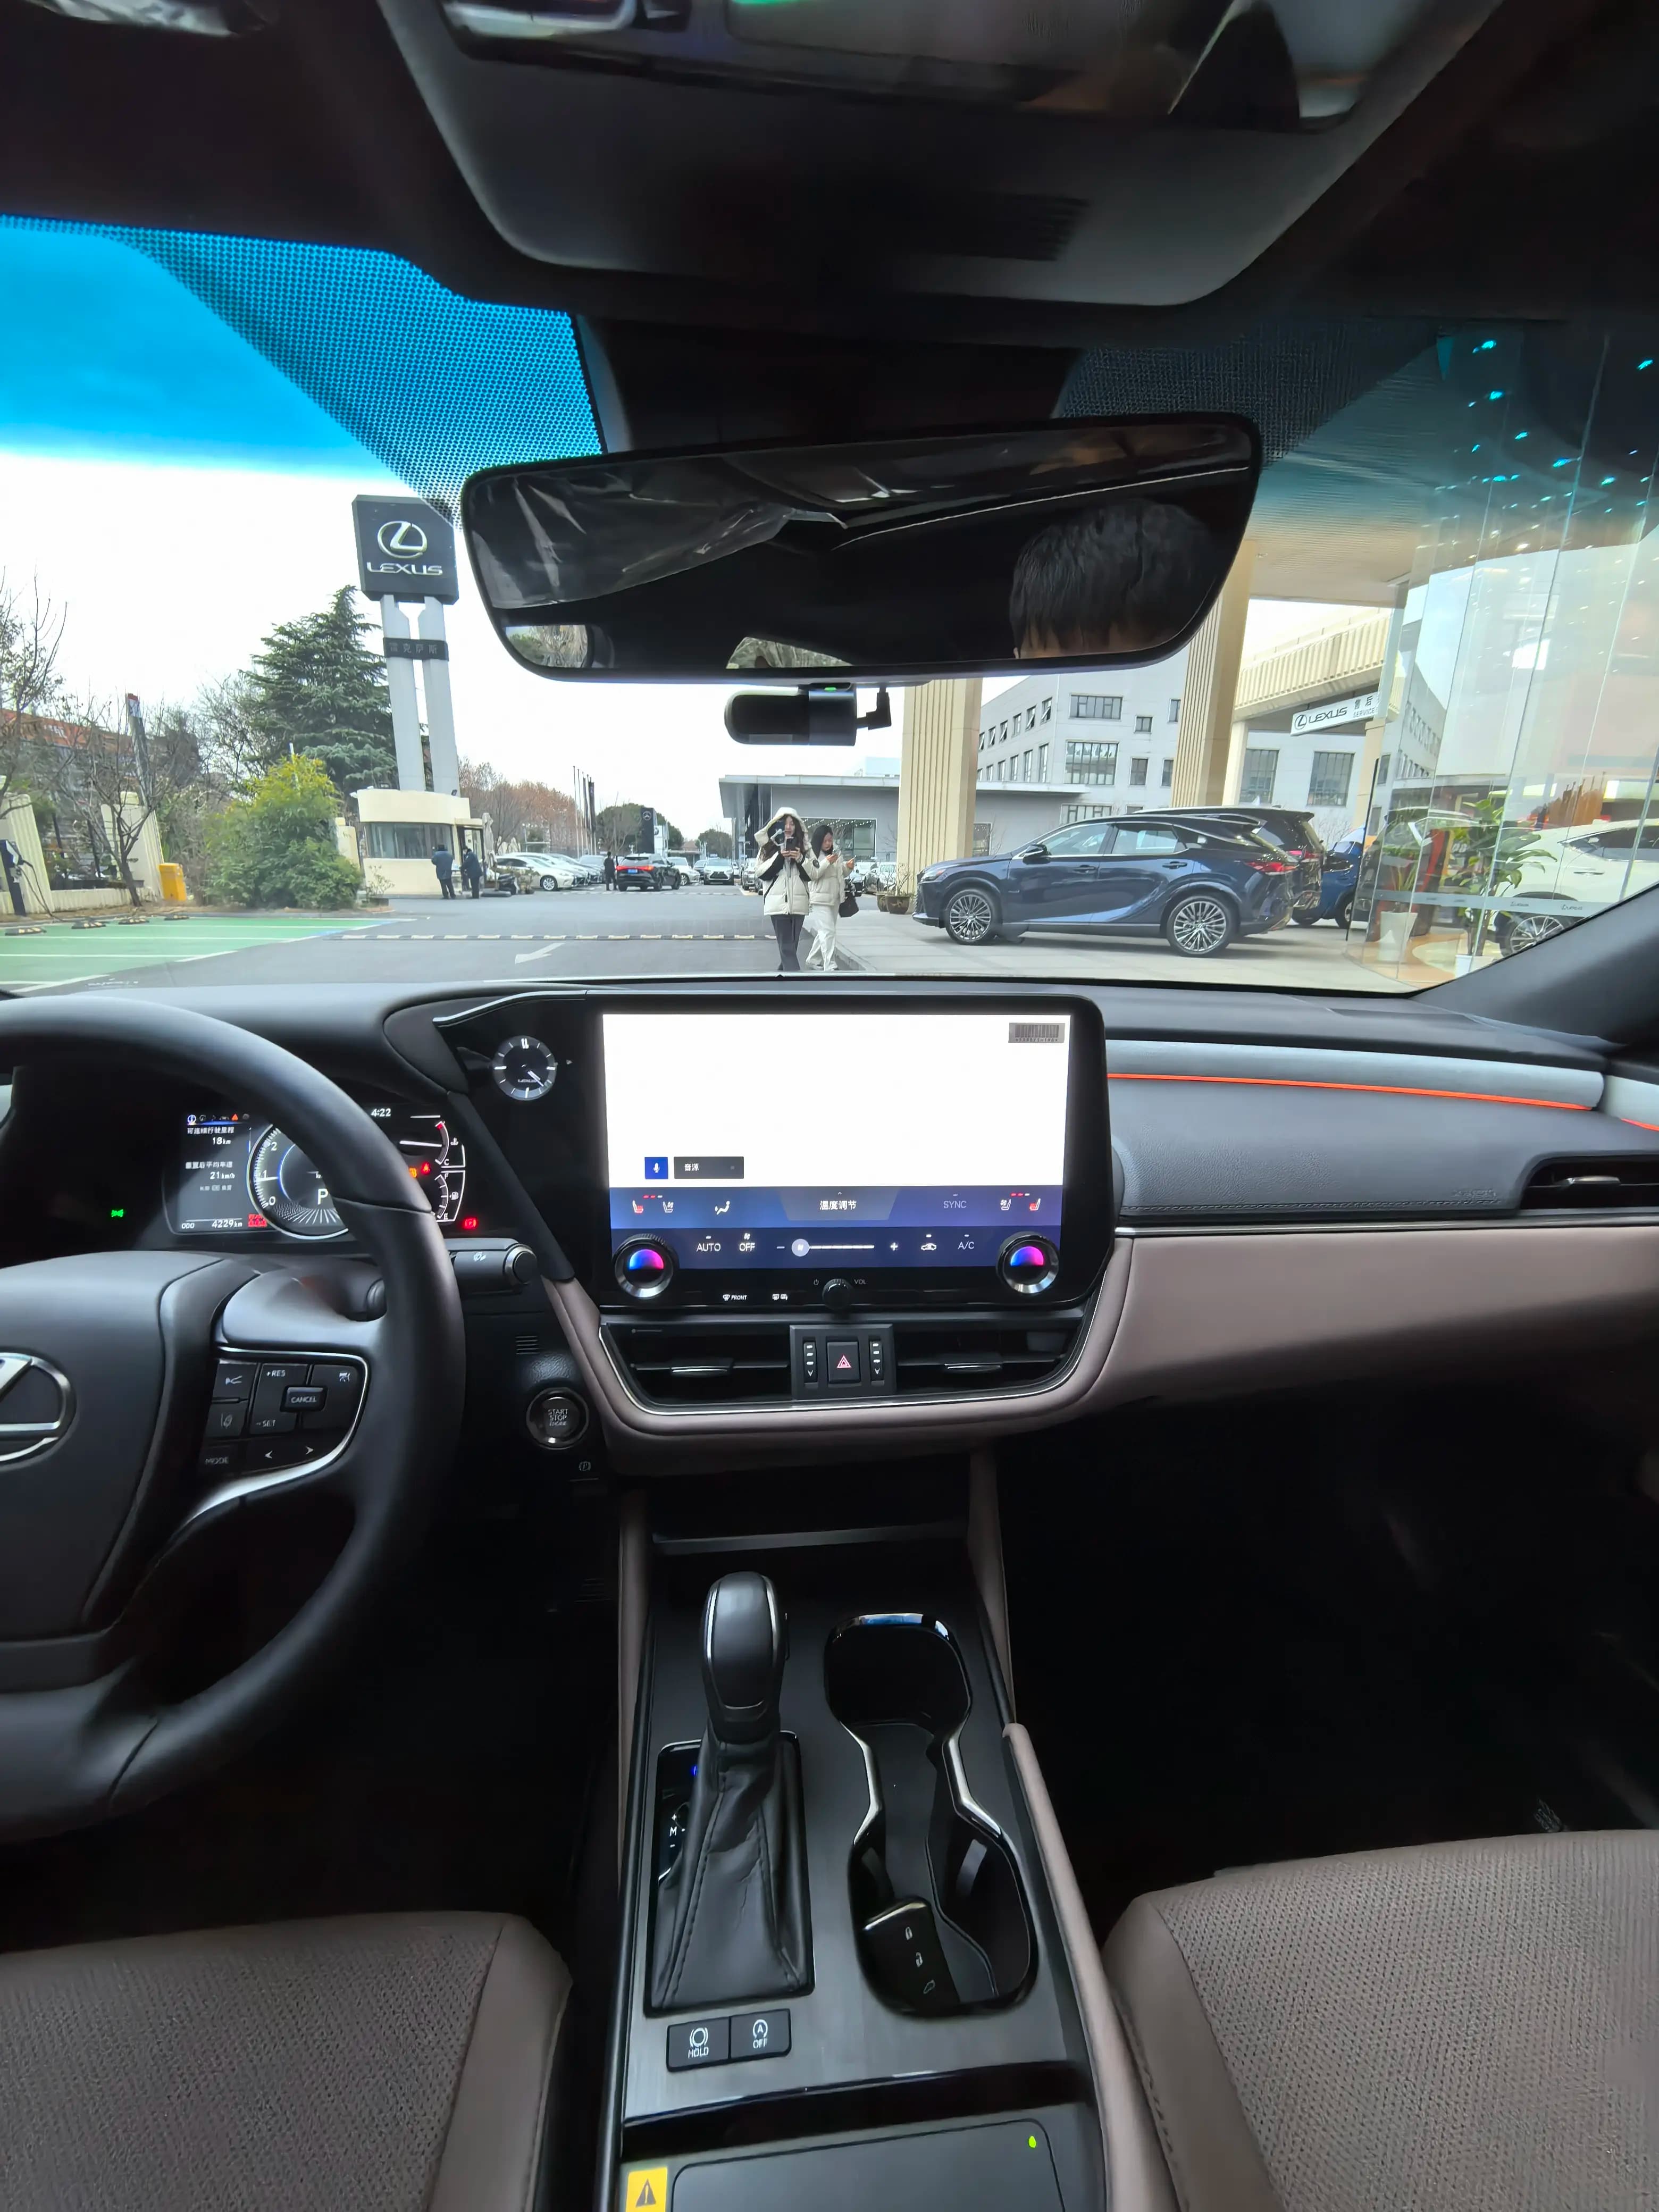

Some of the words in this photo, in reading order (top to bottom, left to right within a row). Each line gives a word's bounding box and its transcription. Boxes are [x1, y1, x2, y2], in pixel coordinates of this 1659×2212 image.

[366, 562, 443, 576] LEXUS
[1309, 707, 1347, 724] LEXUS
[1353, 707, 1375, 718] SERVICE
[371, 1108, 391, 1117] 4:22
[684, 1163, 699, 1171] 音源
[317, 1188, 329, 1205] P
[819, 1200, 857, 1210] 温度调节
[943, 1200, 967, 1209] SYNC
[696, 1242, 721, 1252] AUTO
[739, 1243, 756, 1252] OFF
[958, 1241, 975, 1250] A/C
[670, 1826, 677, 1836] M
[752, 2038, 768, 2049] OFF
[688, 2046, 709, 2059] HOLD
